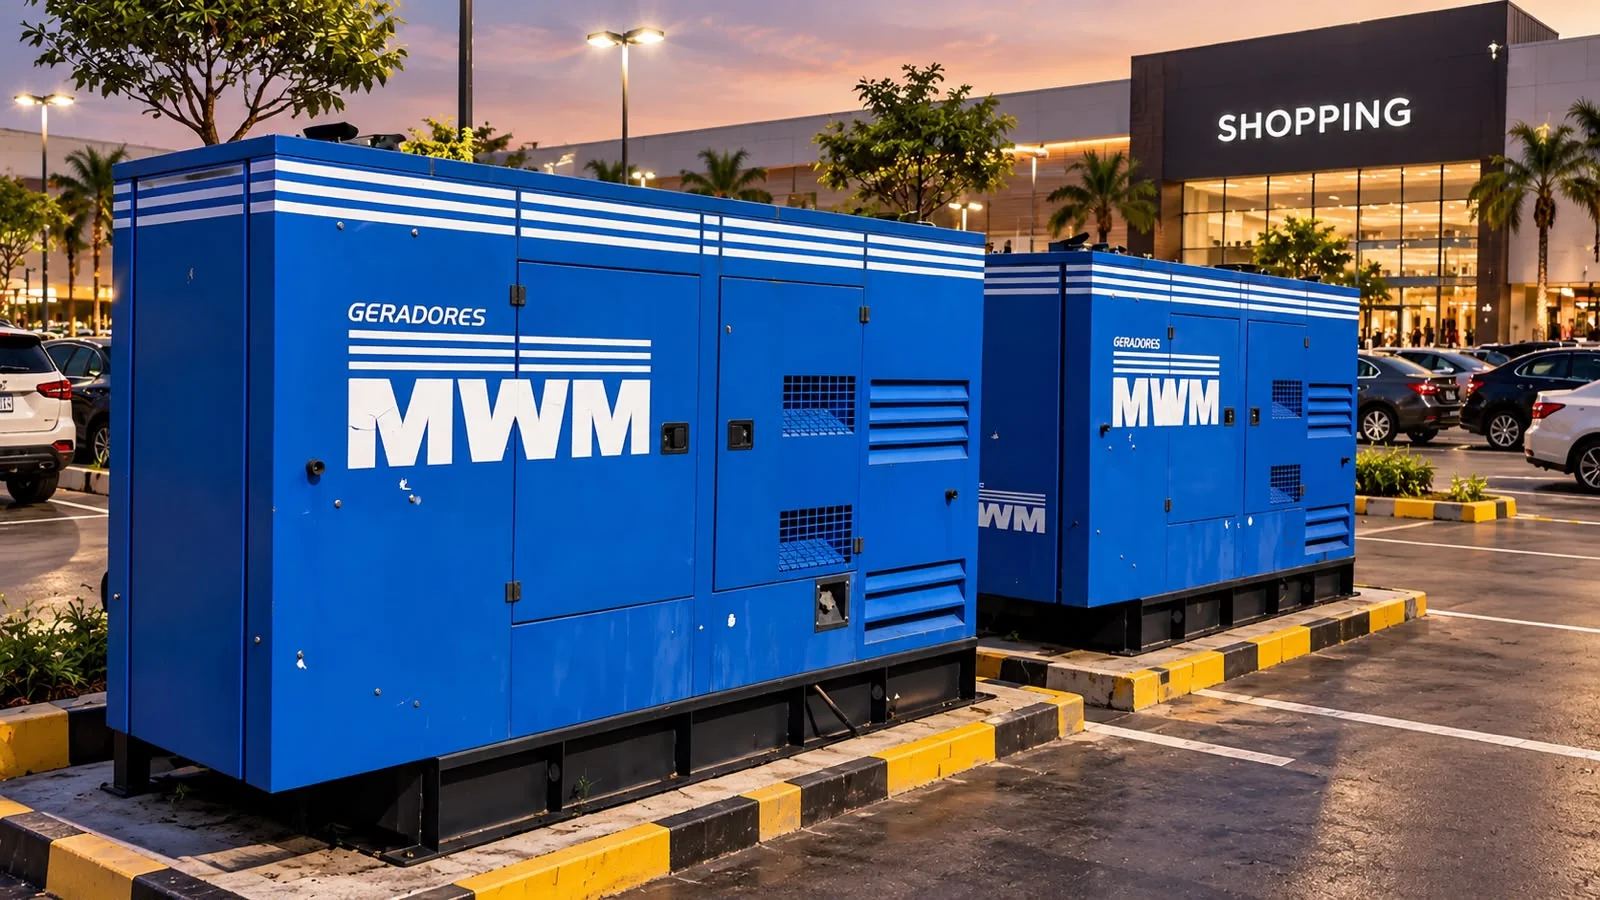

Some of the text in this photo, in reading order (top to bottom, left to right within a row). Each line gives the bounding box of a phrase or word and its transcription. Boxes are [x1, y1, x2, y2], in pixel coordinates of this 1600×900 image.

[1217, 97, 1411, 142] SHOPPING
[348, 302, 486, 326] GERADORES
[1113, 336, 1161, 350] GERADORES
[347, 378, 651, 470] MWM
[1112, 377, 1220, 428] MWM
